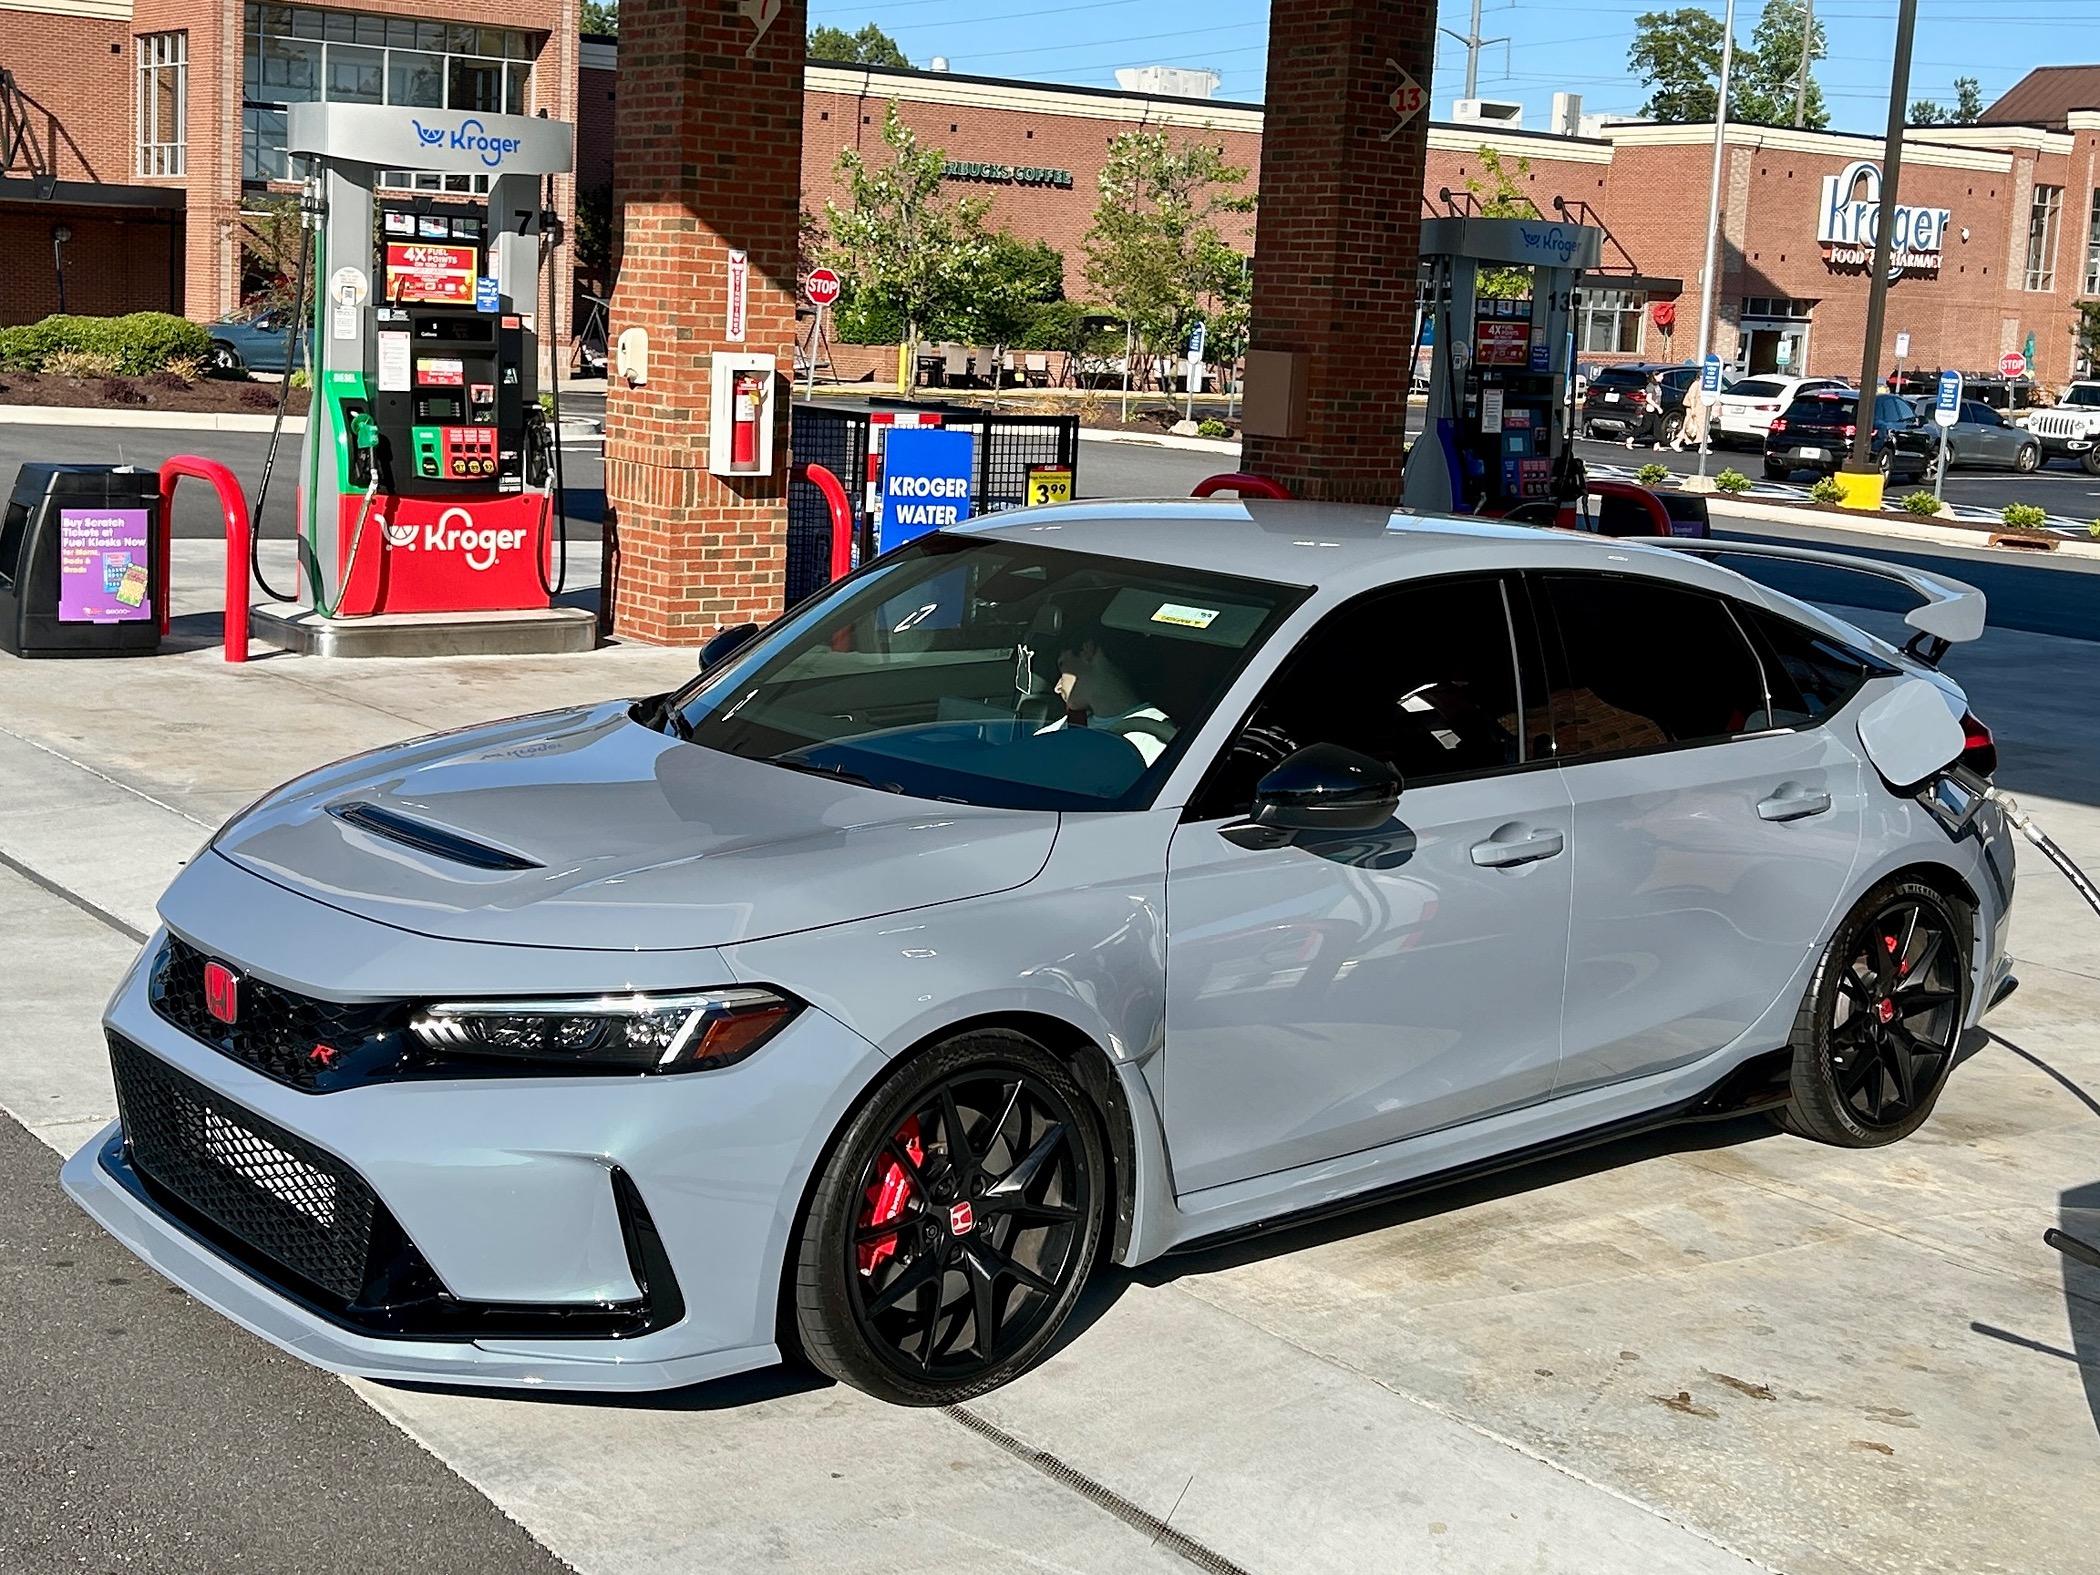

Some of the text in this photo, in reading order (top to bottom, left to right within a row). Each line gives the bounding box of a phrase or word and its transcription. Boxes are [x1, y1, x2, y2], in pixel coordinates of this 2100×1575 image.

[1395, 87, 1421, 112] 13
[450, 119, 521, 167] Kroger
[1014, 167, 1073, 185] COFFEE
[514, 210, 533, 237] 7
[1820, 161, 1950, 280] Kroger
[427, 248, 449, 257] FUEL
[1543, 227, 1581, 262] Kroger
[403, 247, 427, 263] 4X
[427, 255, 458, 265] POINTS
[1830, 248, 1865, 265] FOOD
[809, 278, 837, 294] STOP
[1548, 291, 1571, 312] 13
[1488, 324, 1501, 335] 4X
[2001, 359, 2025, 370] STOP
[889, 476, 968, 498] KROGER
[896, 505, 958, 525] WATER
[63, 518, 125, 530] Buy Scratch
[63, 528, 114, 537] Tickets at
[63, 538, 147, 547] Fuel Kiosks Now
[424, 507, 527, 571] Kroger
